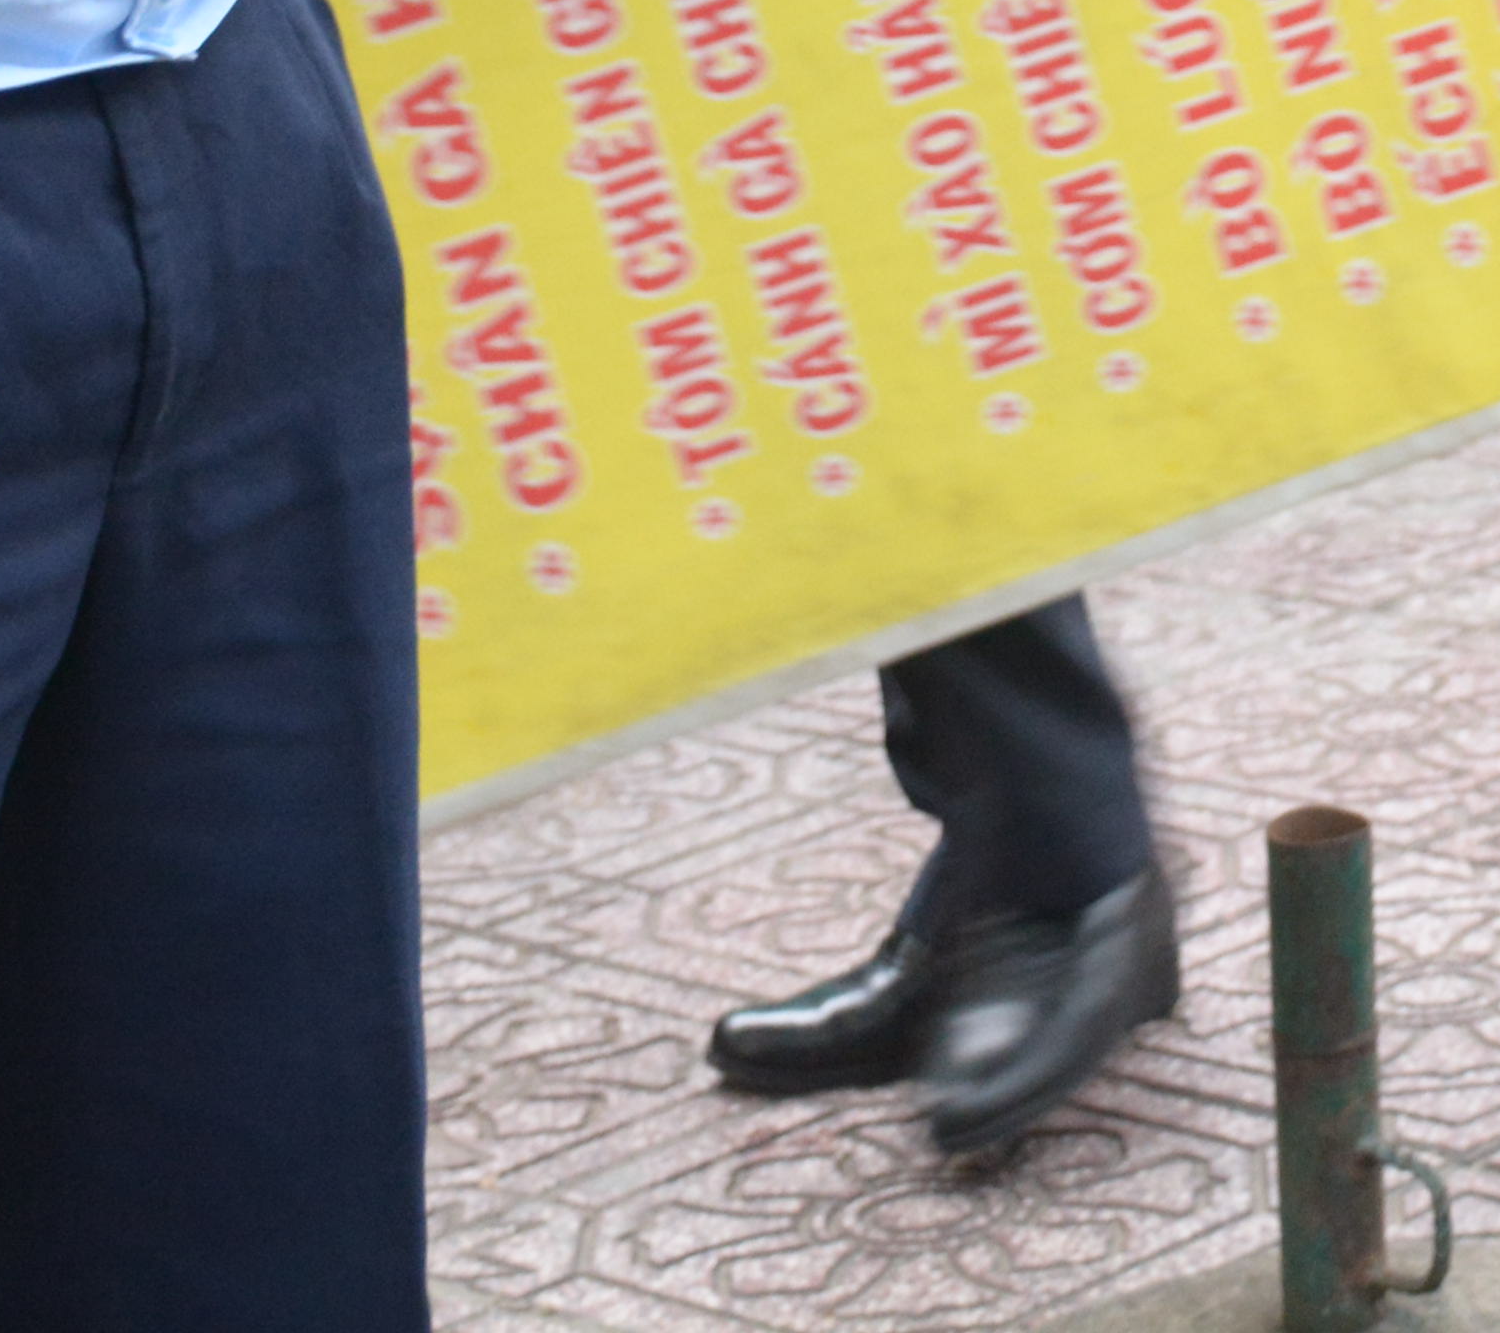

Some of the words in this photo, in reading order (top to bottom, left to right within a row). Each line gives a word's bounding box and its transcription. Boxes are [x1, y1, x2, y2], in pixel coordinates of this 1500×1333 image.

[391, 65, 488, 204] GÀ
[568, 66, 692, 294] CHIÊN
[714, 113, 800, 215] GÀ
[908, 114, 1007, 263] XÀO
[1299, 113, 1391, 234] BÒ
[1051, 167, 1153, 330] CƠM
[1193, 150, 1285, 272] BÒ
[438, 230, 580, 509] CHÂN
[641, 309, 746, 482] TÔM
[923, 278, 1039, 373] MÌ
